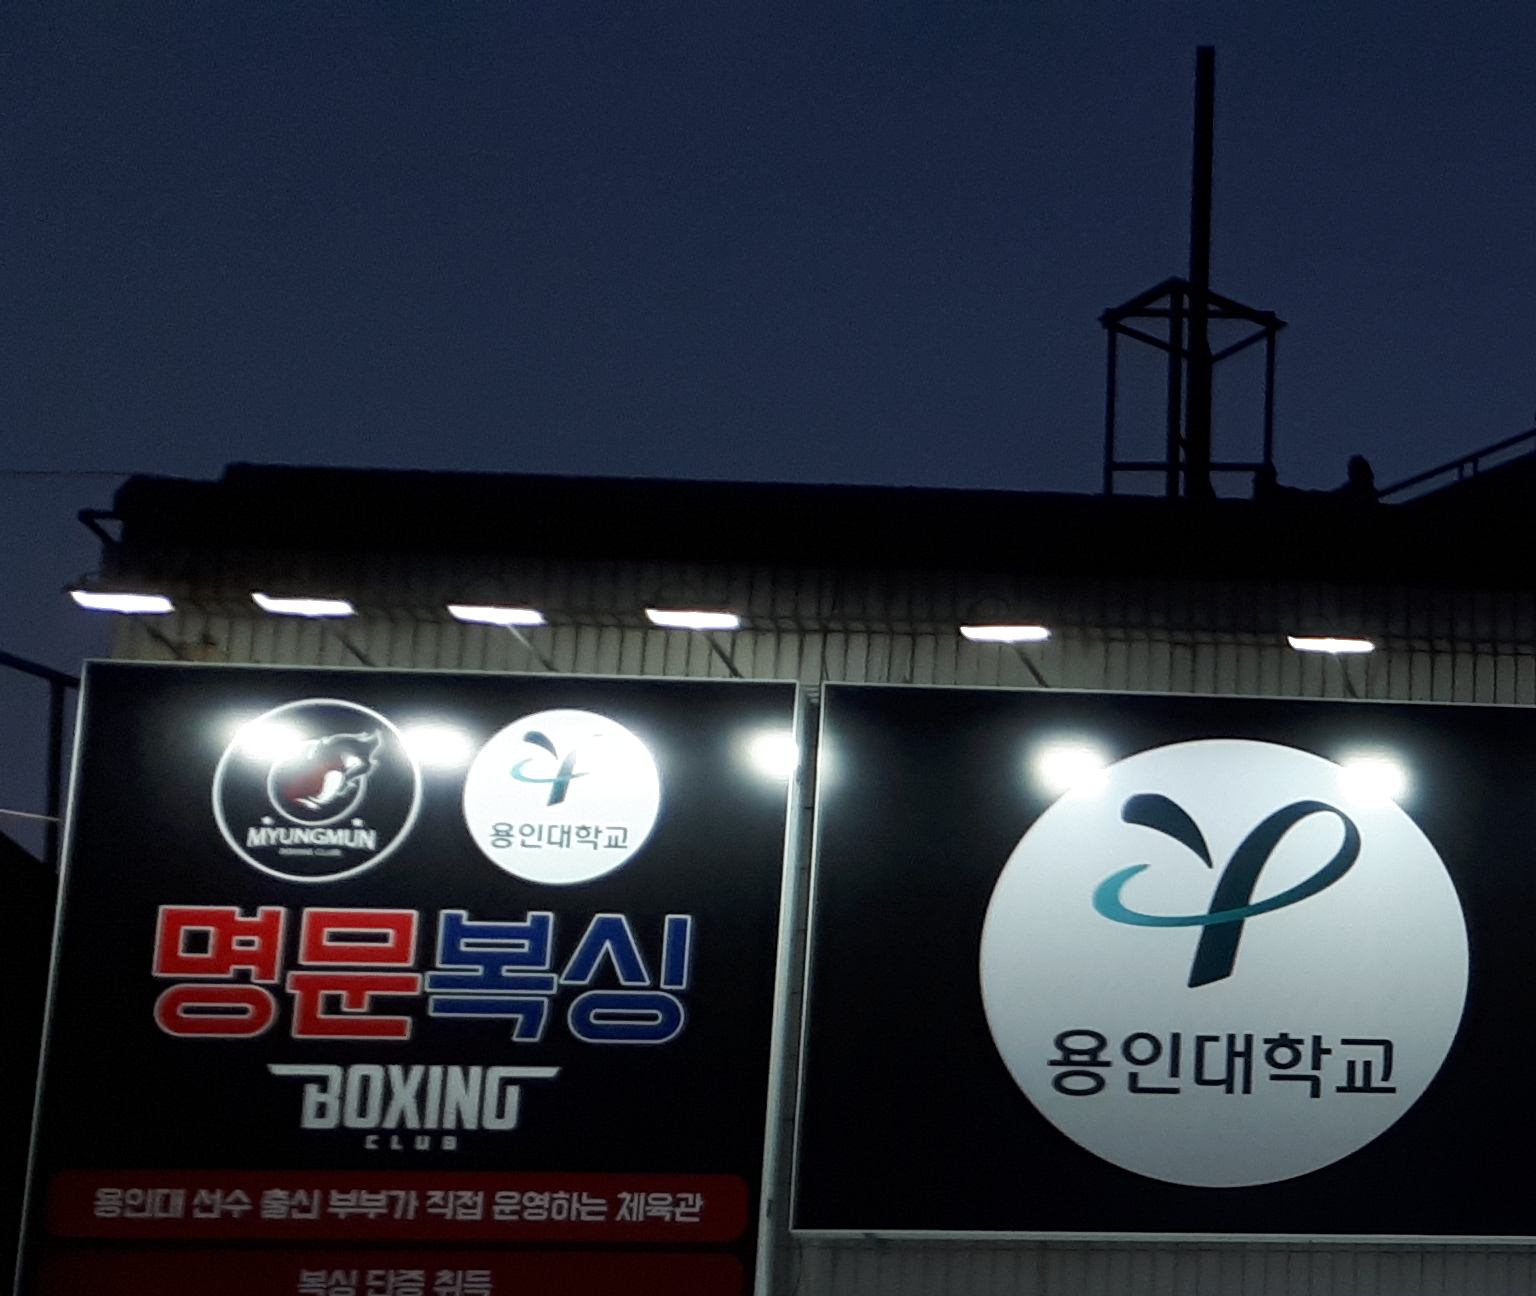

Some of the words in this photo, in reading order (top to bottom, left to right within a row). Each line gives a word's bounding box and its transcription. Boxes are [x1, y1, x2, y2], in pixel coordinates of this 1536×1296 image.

[246, 826, 377, 850] MYUNGMUN
[489, 821, 629, 851] 용인대학교
[152, 904, 693, 1044] 명문복싱
[1046, 1028, 1397, 1099] 용인대학교
[266, 1063, 562, 1130] BOXING
[364, 1134, 459, 1151] CLUB
[93, 1187, 188, 1219] 용인대
[191, 1188, 253, 1219] 선수
[259, 1188, 322, 1220] 출신
[327, 1189, 420, 1220] 부부가
[425, 1190, 486, 1221] 직접
[491, 1190, 608, 1222] 운영하는
[614, 1191, 705, 1223] 체육관
